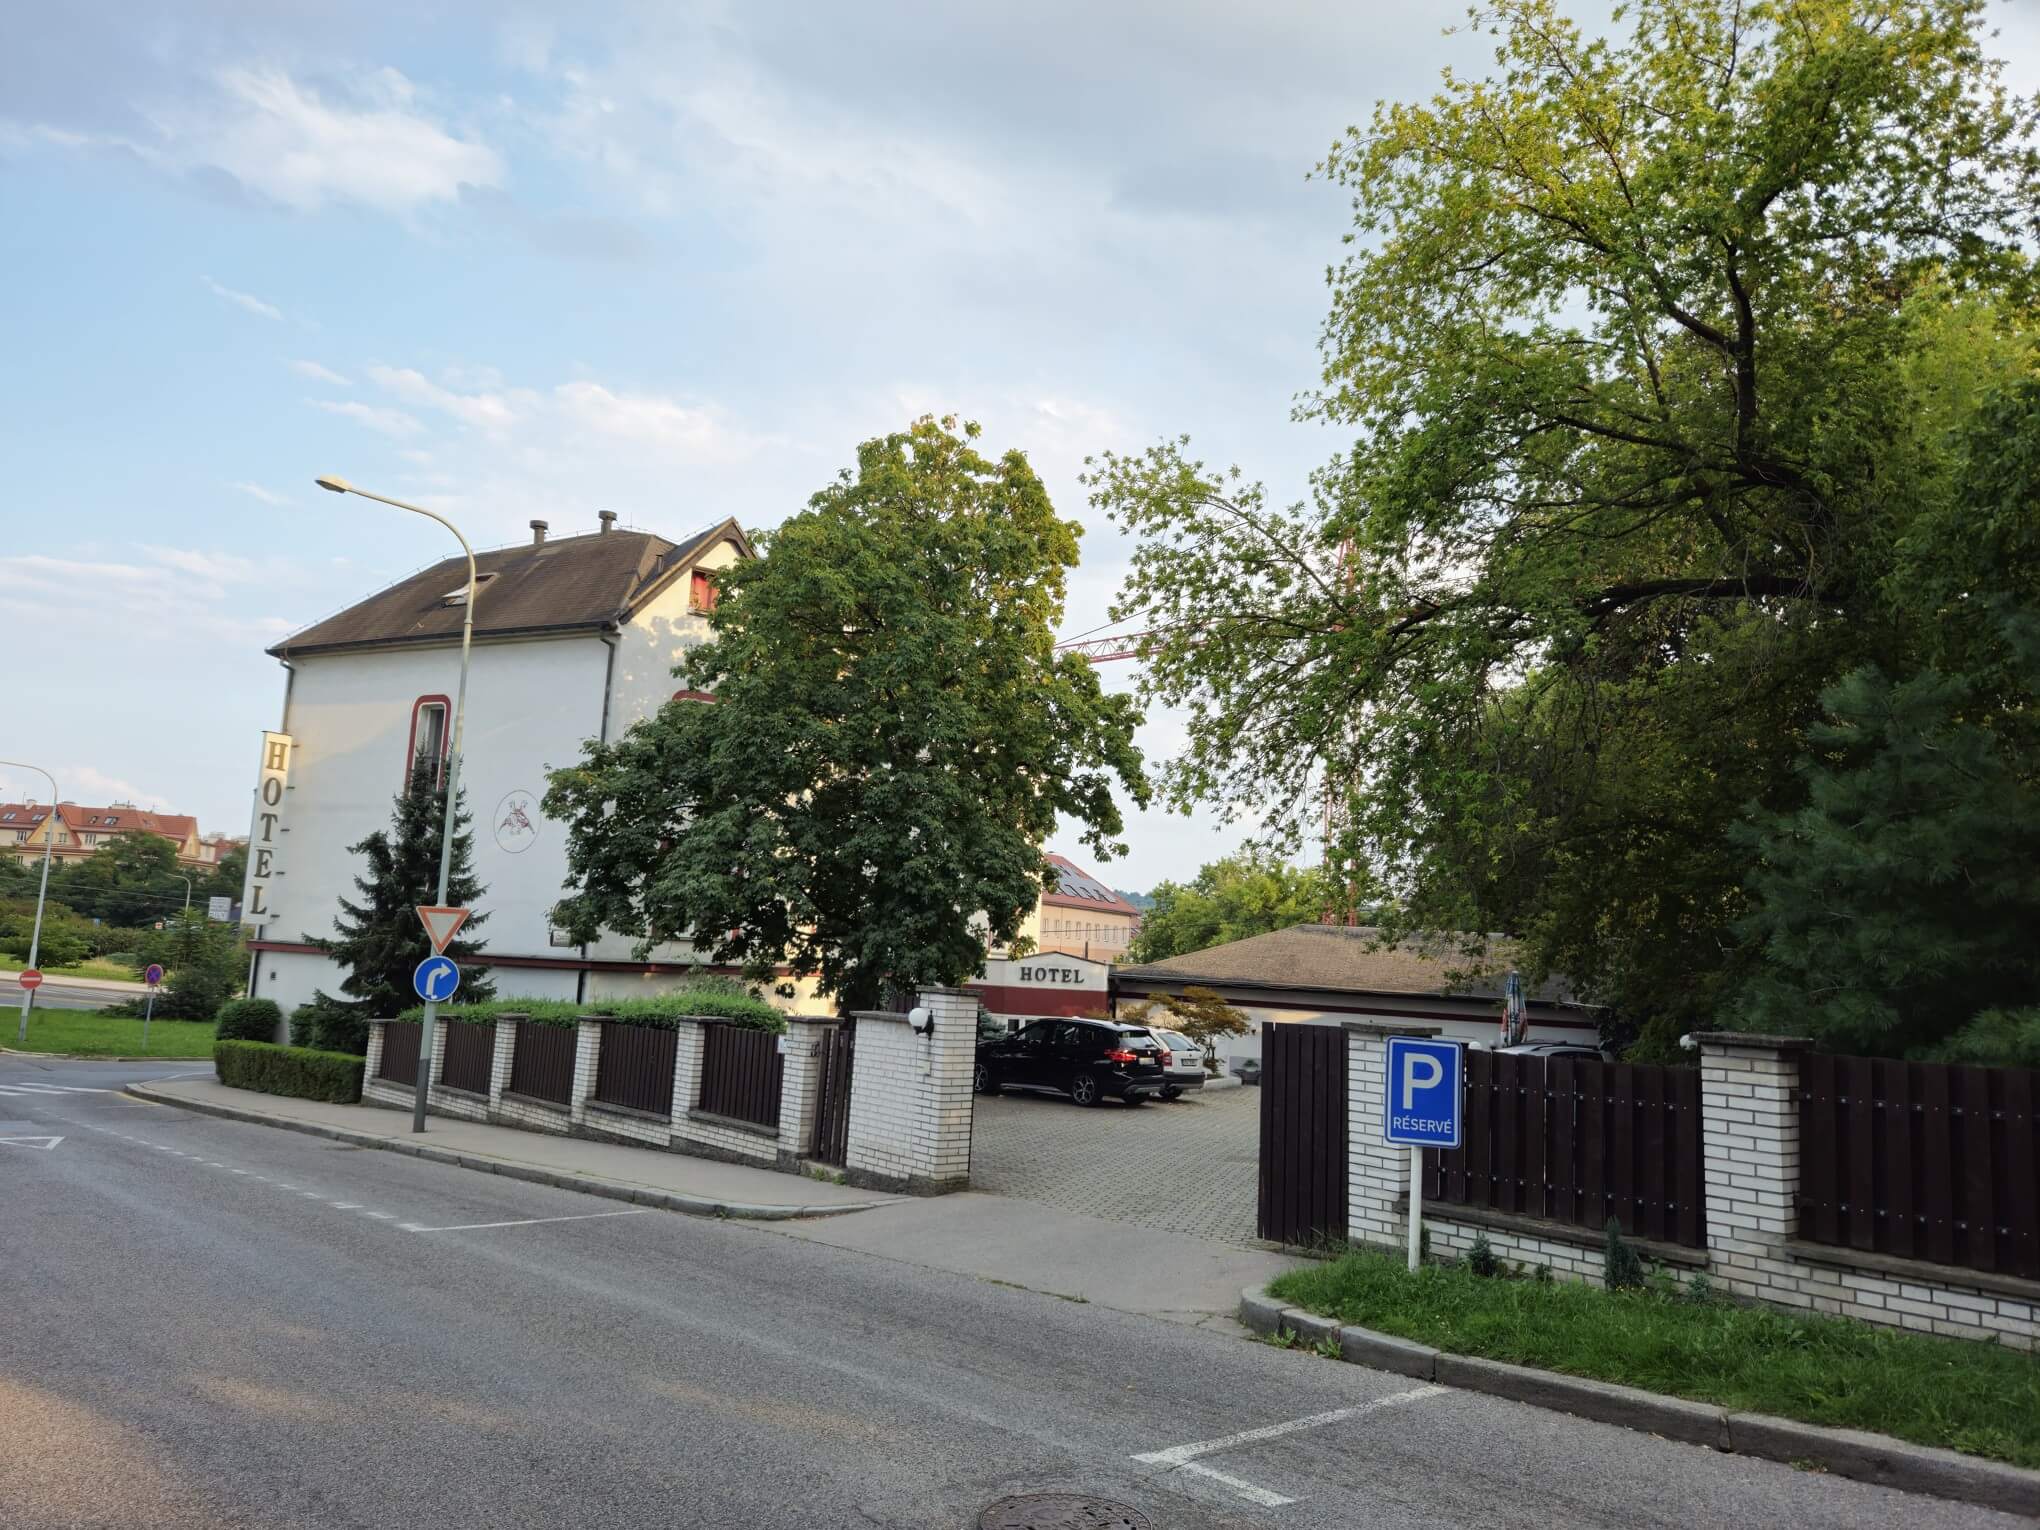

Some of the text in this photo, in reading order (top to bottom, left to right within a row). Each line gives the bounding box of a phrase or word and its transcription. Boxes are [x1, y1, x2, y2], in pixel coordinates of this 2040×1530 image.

[250, 741, 288, 915] HOTEL
[1020, 966, 1085, 984] HOTEL
[1402, 1052, 1443, 1110] P
[1393, 1115, 1453, 1134] RÉSERVÉ
